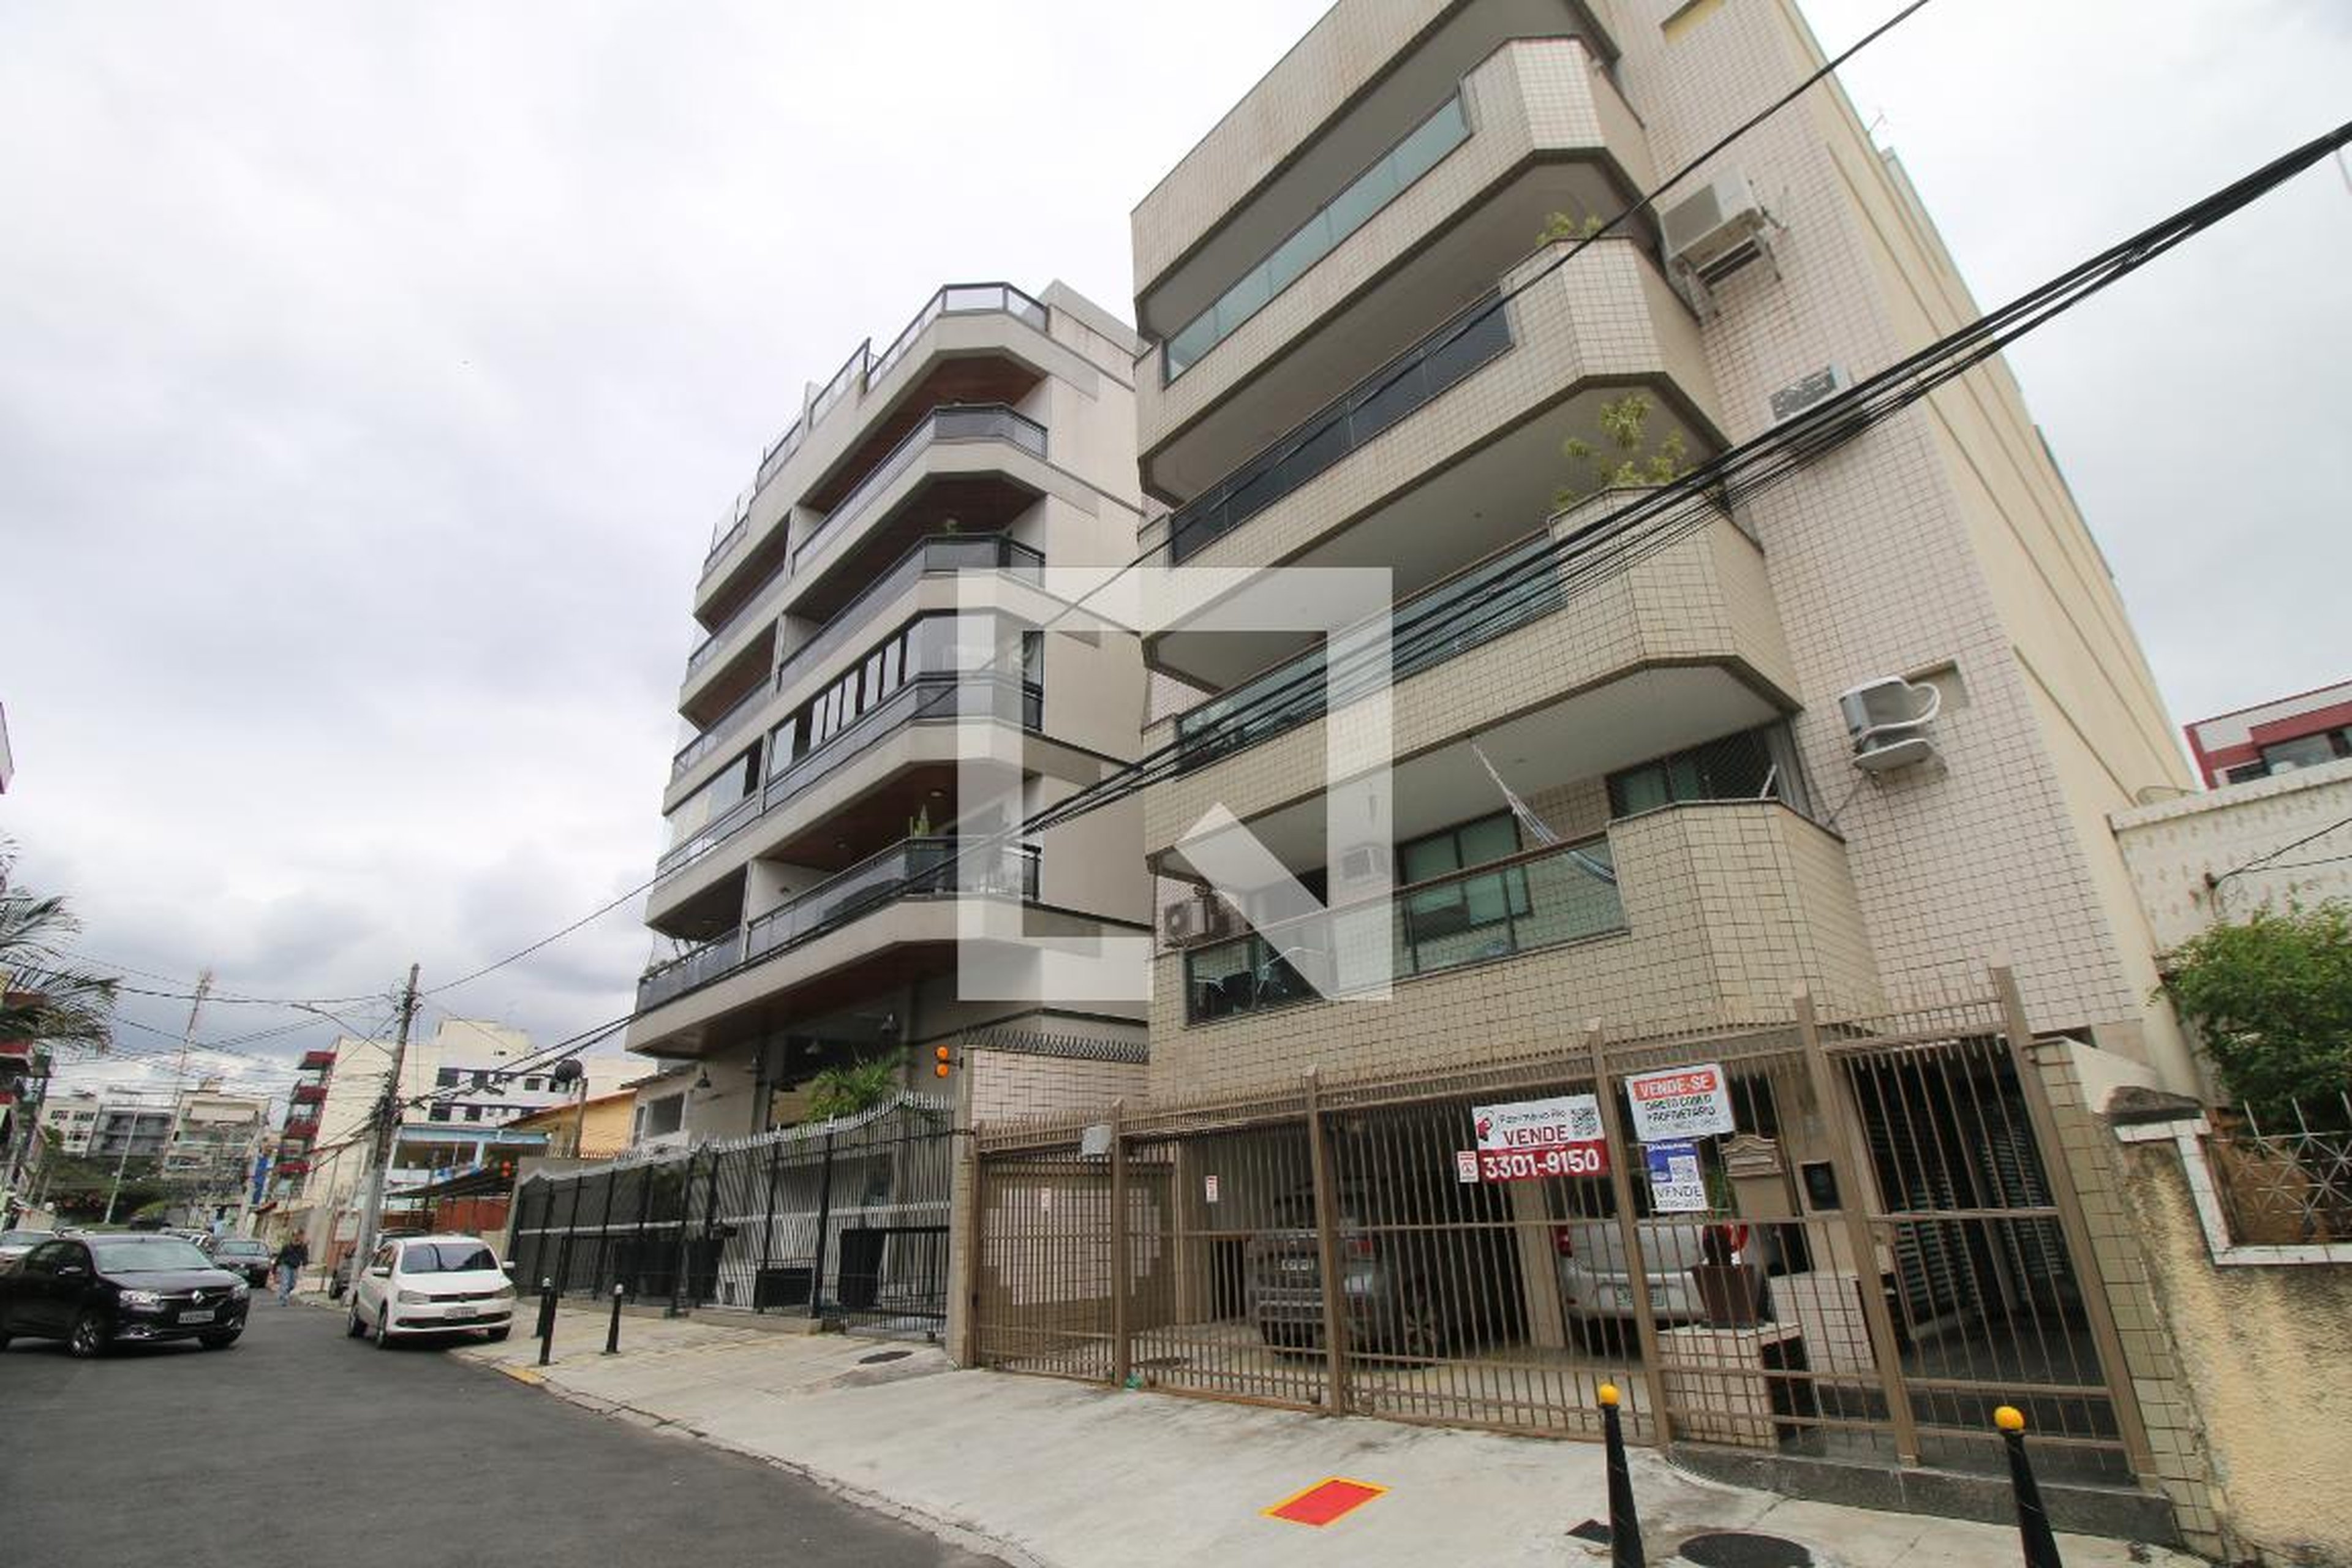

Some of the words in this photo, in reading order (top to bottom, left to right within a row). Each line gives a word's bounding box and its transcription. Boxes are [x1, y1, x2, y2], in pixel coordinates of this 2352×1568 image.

[1502, 1124, 1569, 1146] VENDE
[1483, 1148, 1600, 1179] 3301-9150
[1656, 1185, 1703, 1198] VENDE
